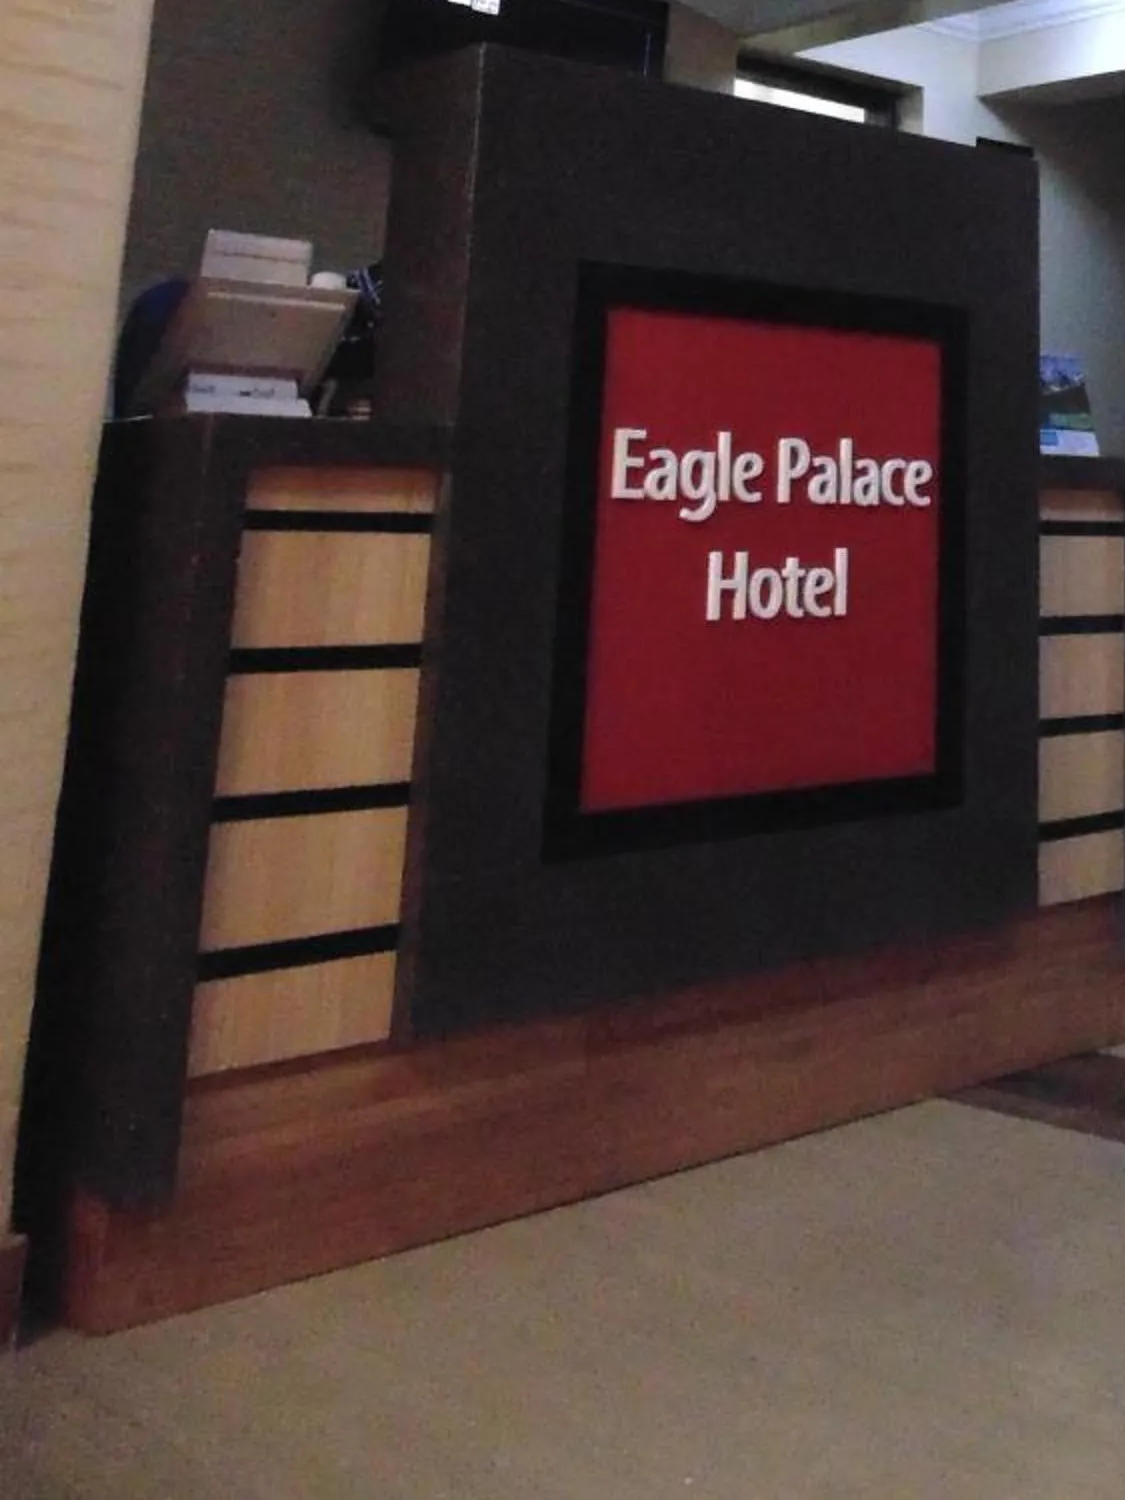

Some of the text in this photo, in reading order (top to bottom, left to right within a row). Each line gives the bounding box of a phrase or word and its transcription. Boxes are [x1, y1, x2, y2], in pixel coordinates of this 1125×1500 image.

[610, 427, 934, 523] Eagle Palace
[705, 547, 849, 622] Hotel
